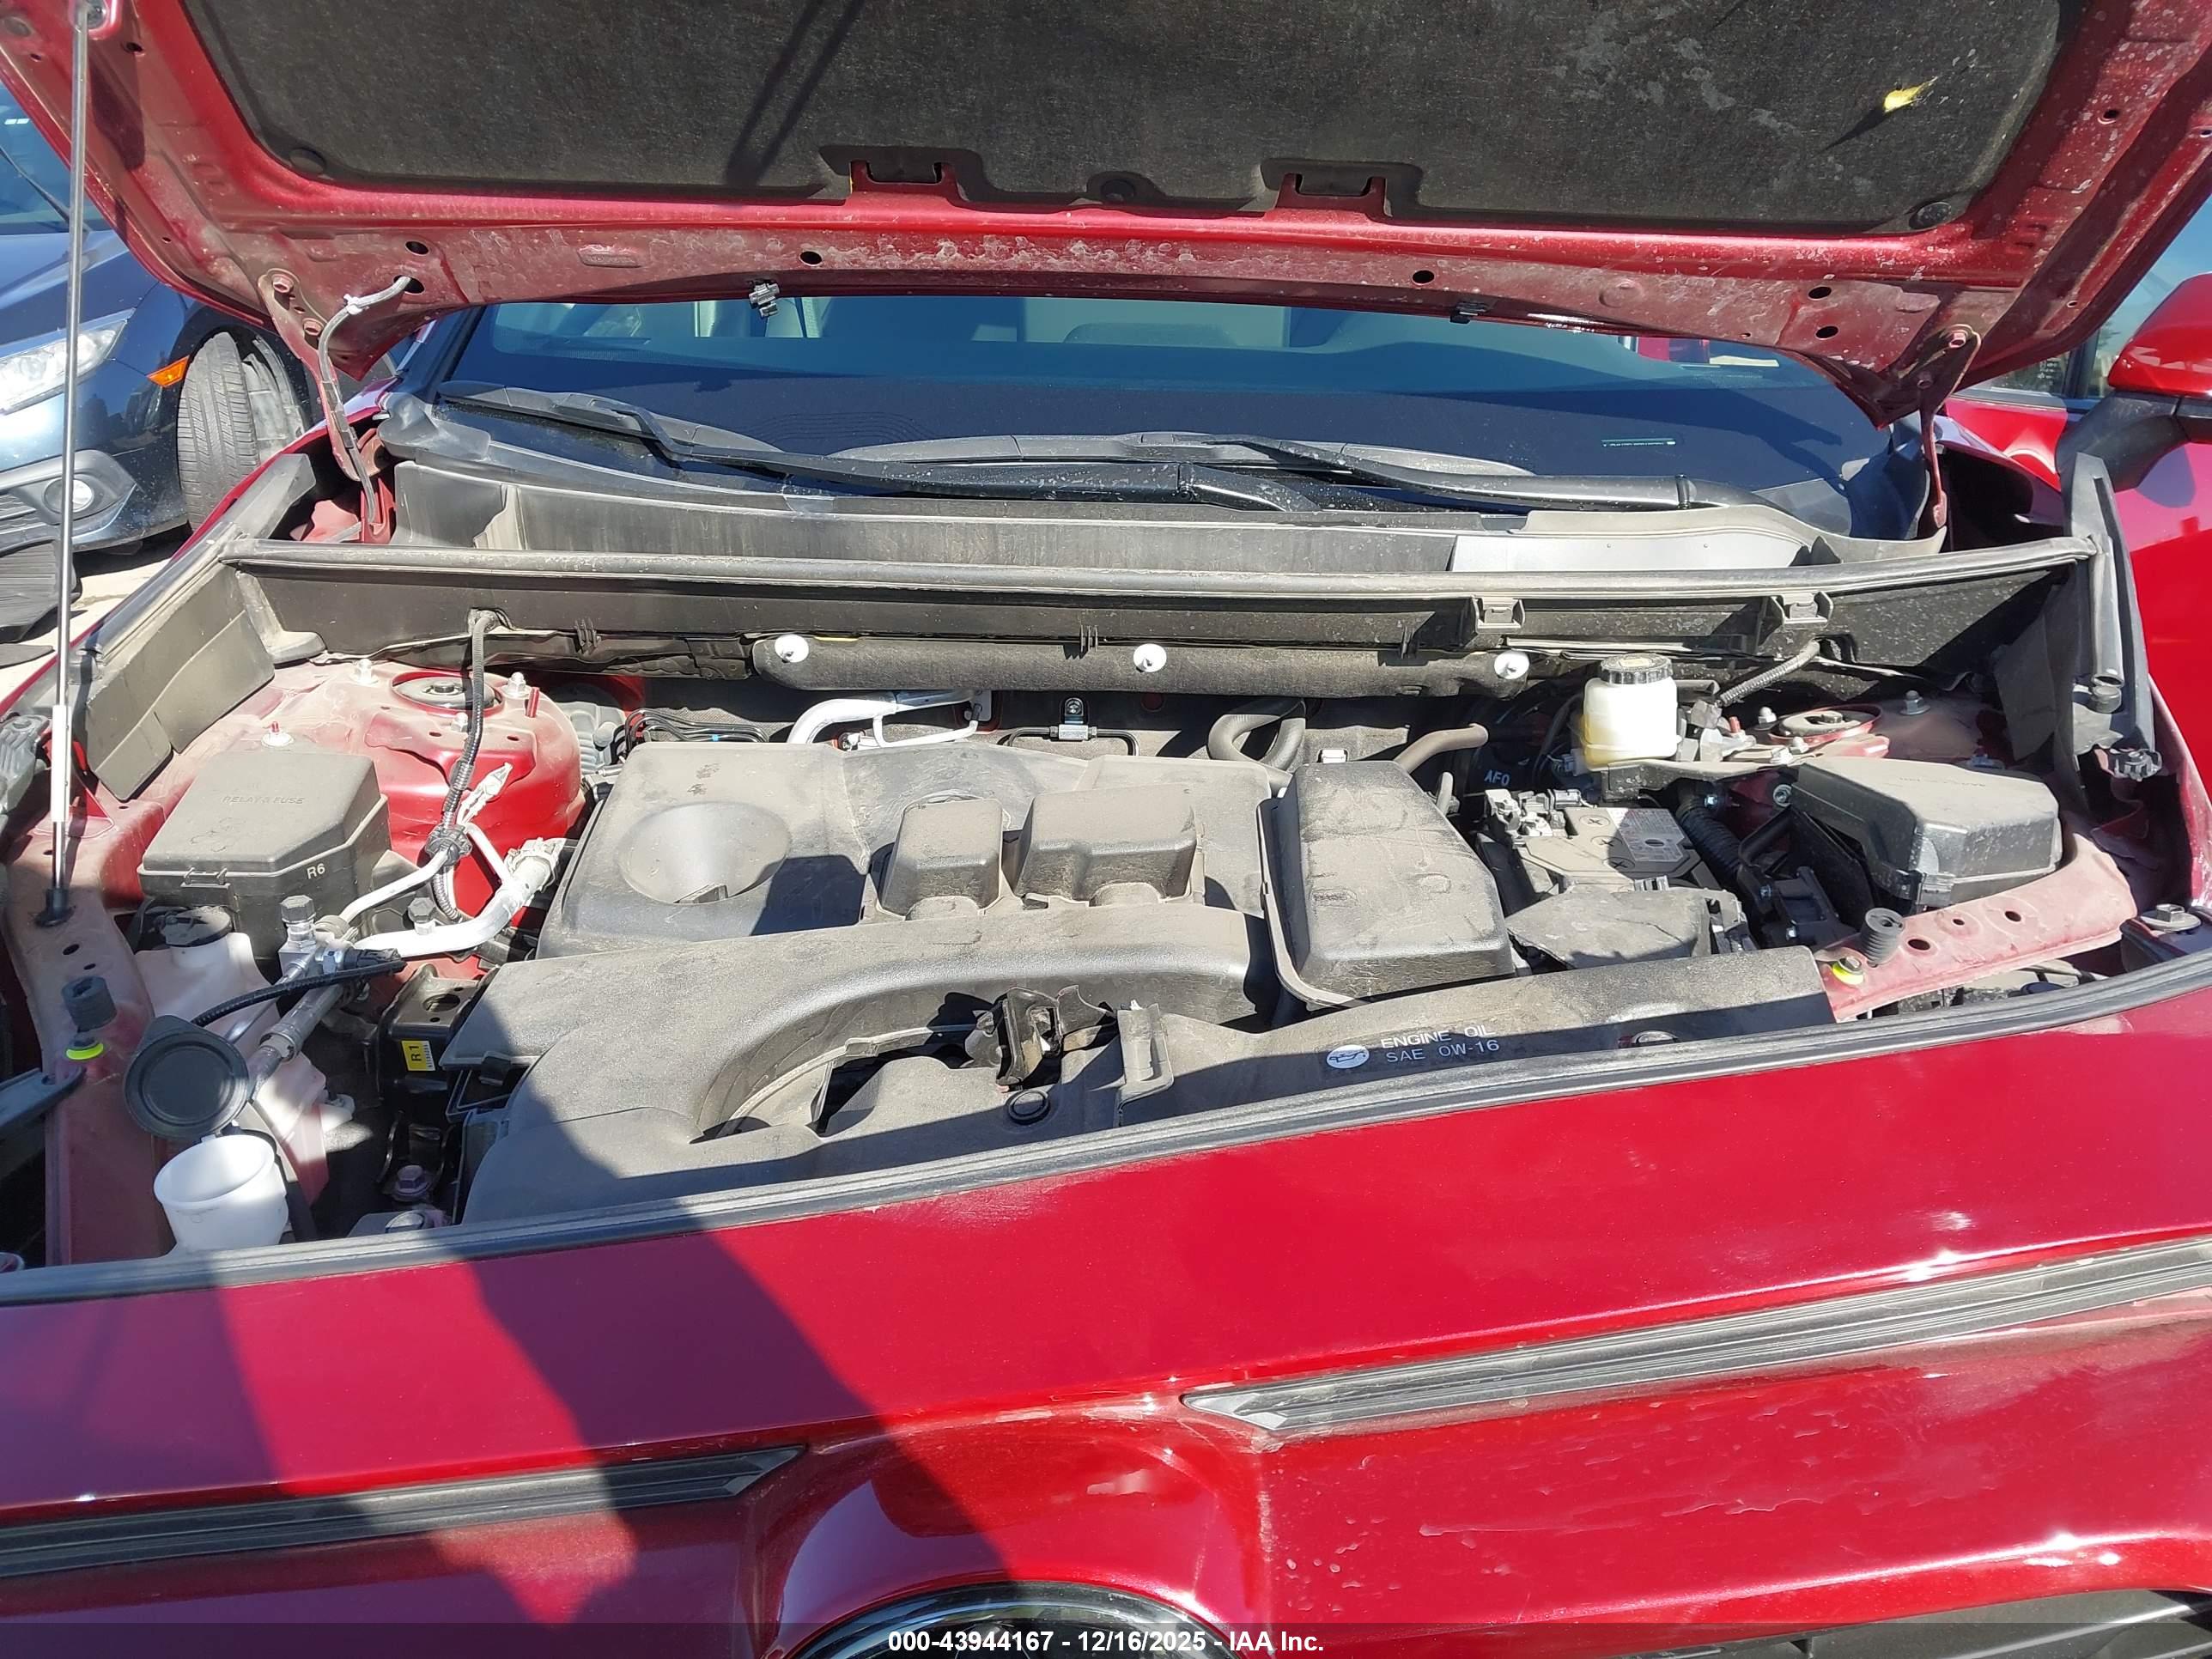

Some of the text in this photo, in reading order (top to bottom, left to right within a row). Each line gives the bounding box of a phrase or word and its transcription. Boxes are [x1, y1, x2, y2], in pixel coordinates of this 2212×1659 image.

[273, 795, 305, 805] FUSE
[307, 862, 325, 879] R6
[1381, 1024, 1496, 1048] ENGINE OIL
[1386, 1039, 1499, 1062] SAE 0W-16
